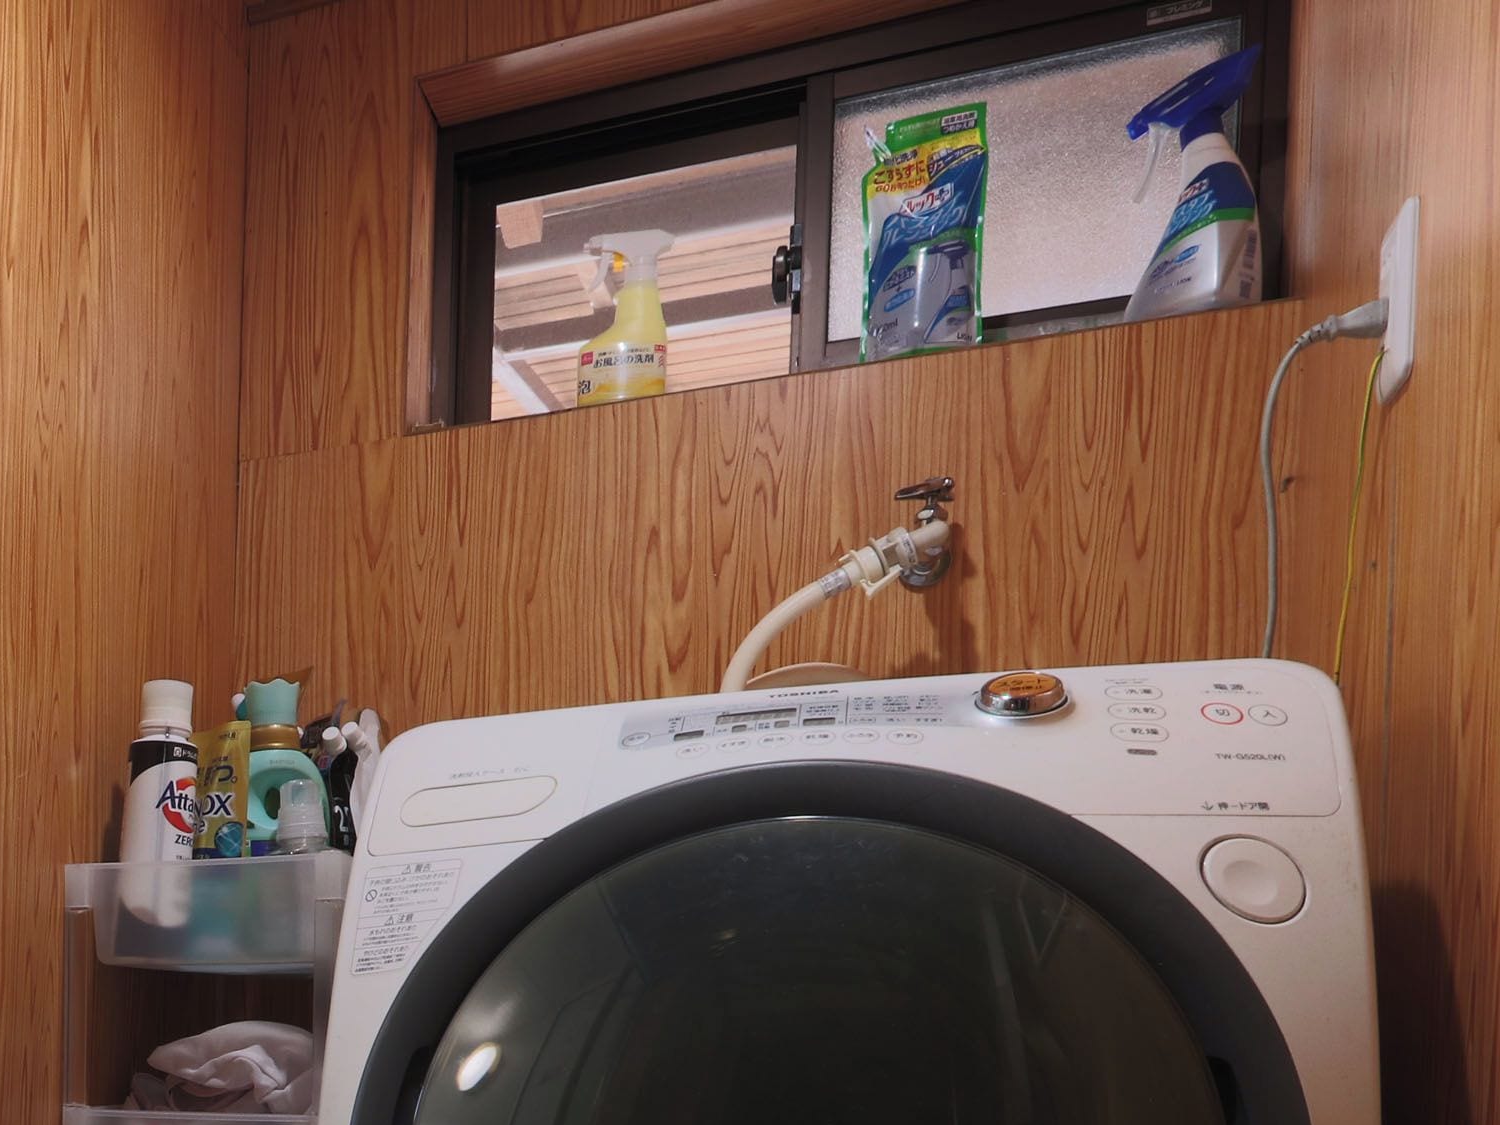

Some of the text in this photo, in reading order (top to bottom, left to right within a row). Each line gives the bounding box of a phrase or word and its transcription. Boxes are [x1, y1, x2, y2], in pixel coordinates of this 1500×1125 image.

[873, 161, 926, 185] こすらずに
[593, 354, 654, 368] お風呂の洗剤
[769, 690, 839, 698] TOSHIBA
[1215, 708, 1231, 717] 切
[156, 780, 194, 813] Atta
